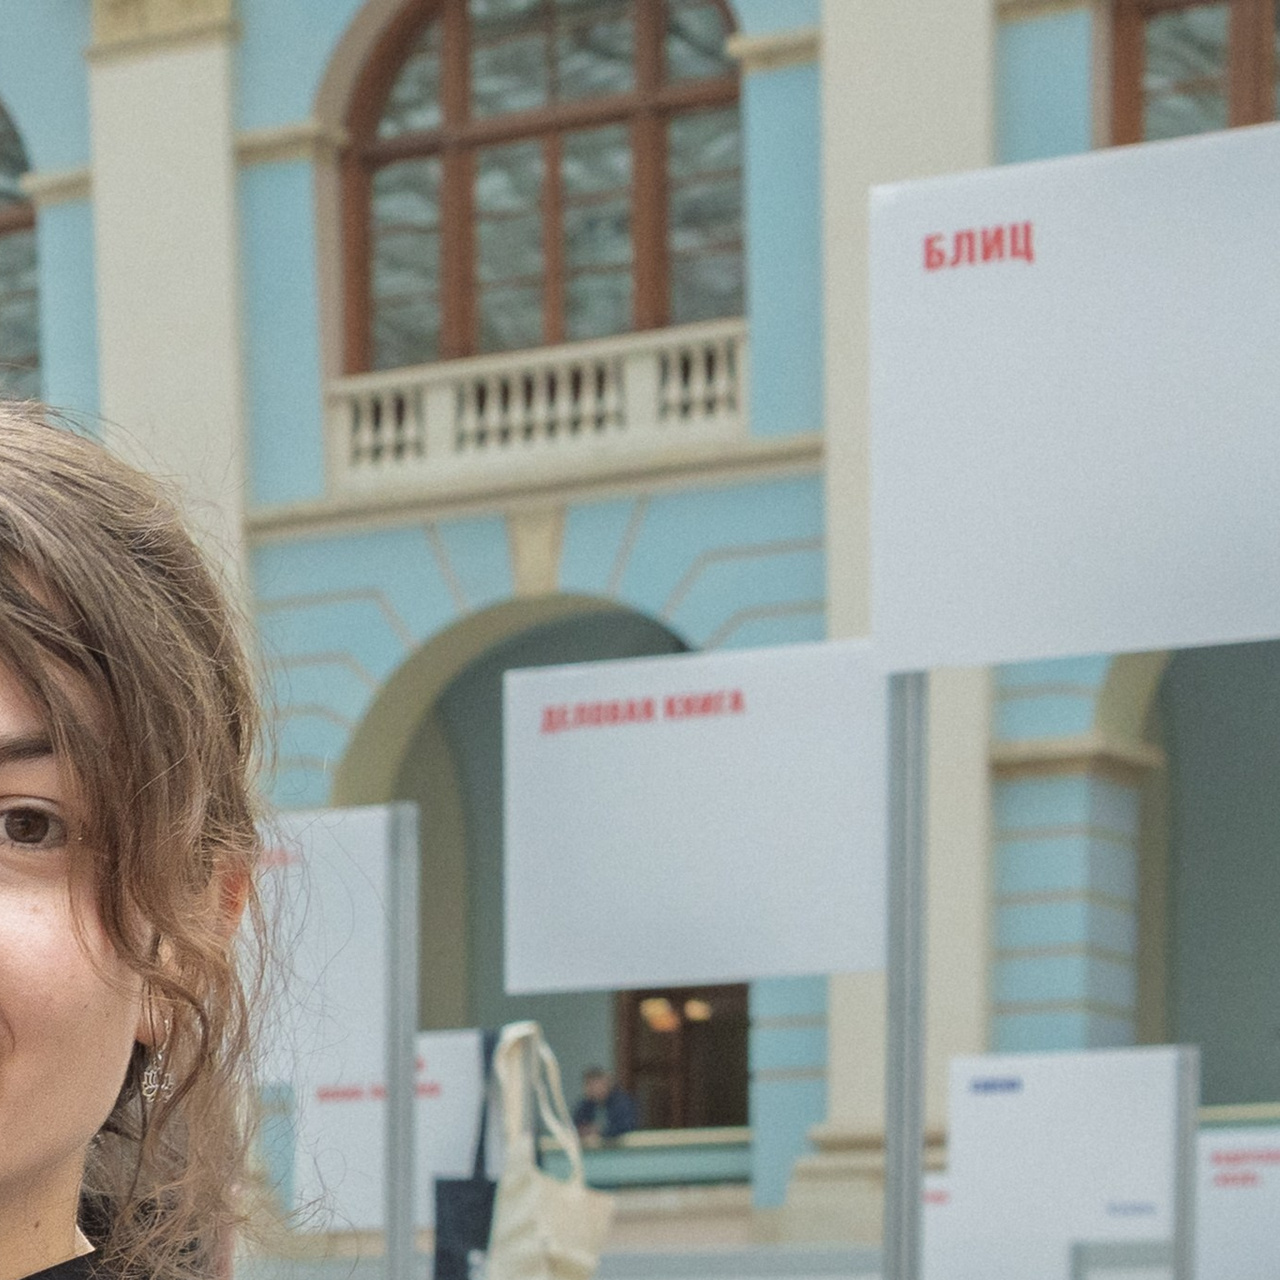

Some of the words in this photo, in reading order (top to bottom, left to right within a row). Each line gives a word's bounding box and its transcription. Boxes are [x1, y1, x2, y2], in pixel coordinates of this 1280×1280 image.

[924, 222, 1035, 271] БЛИЦ
[541, 698, 655, 734] ДЕЛОВАЯ
[664, 690, 744, 719] КНИГА
